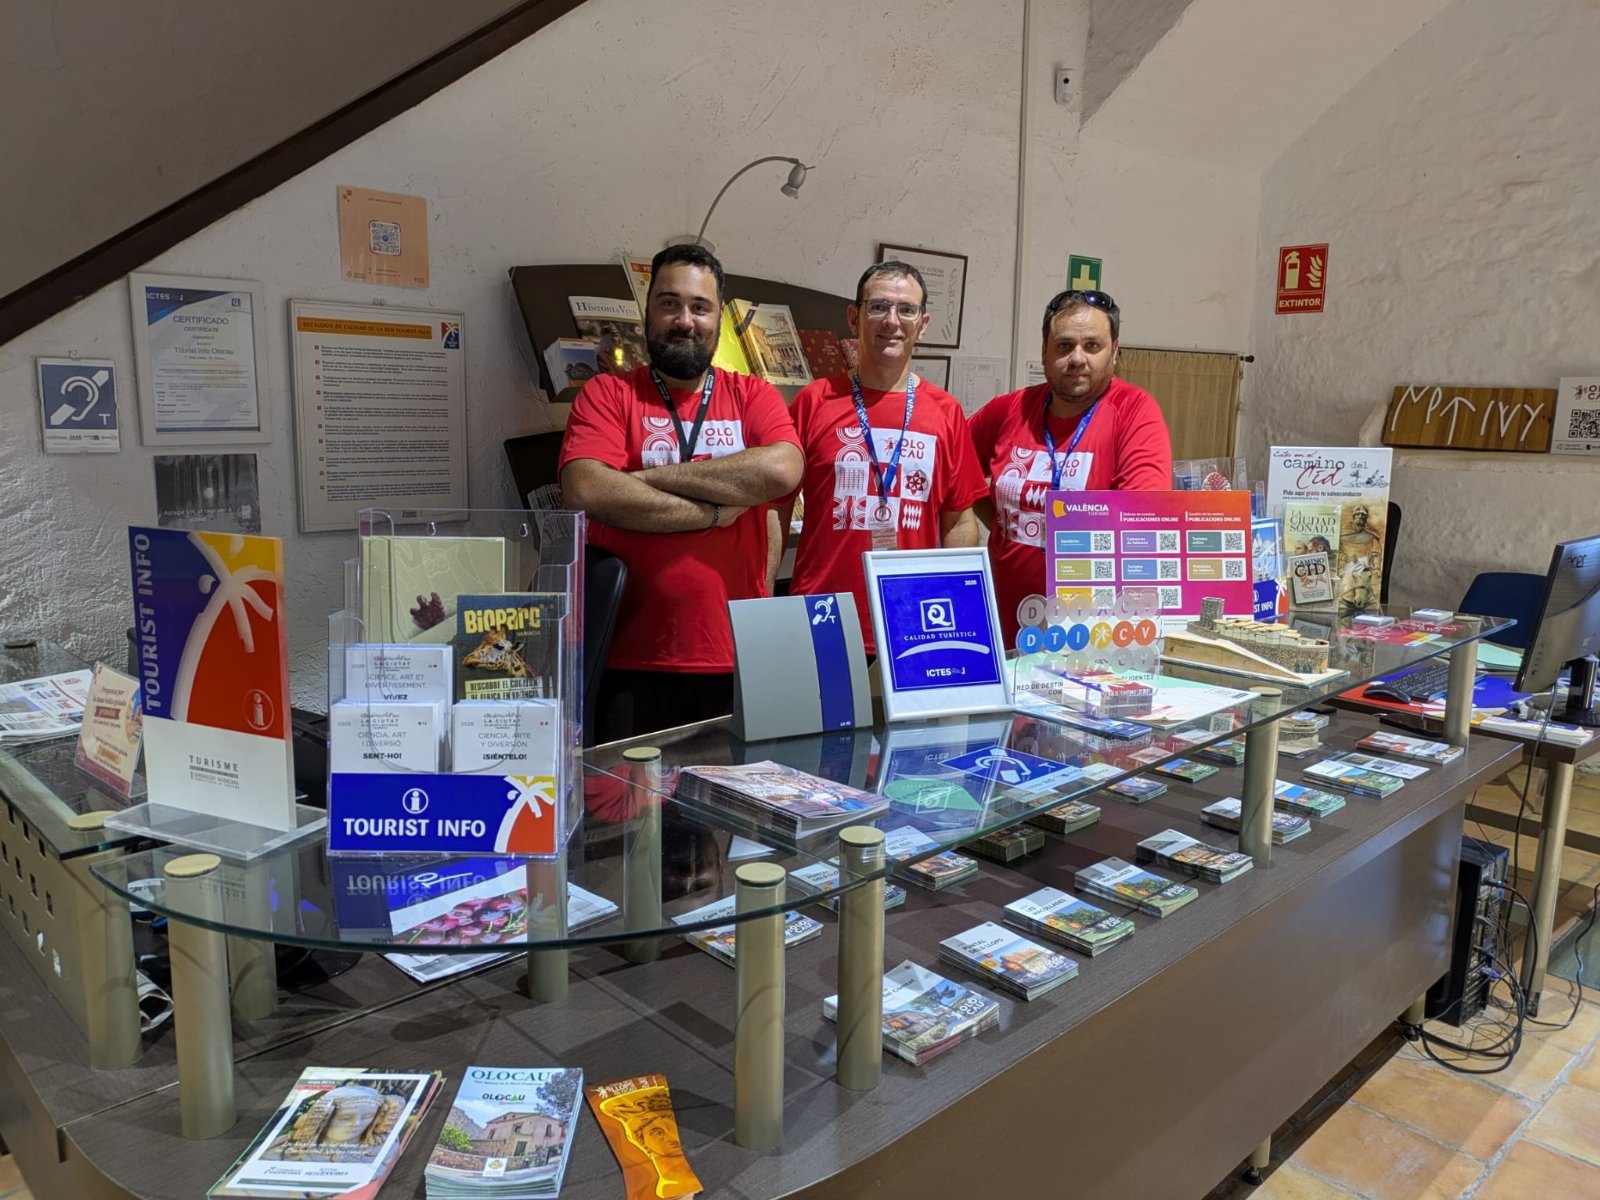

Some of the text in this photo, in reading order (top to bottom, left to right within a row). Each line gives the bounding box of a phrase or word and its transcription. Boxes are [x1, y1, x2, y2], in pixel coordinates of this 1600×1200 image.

[1280, 298, 1321, 308] EXTINTOR
[173, 315, 229, 325] CERTIFICADO
[98, 413, 111, 425] T
[705, 427, 733, 438] OLO
[705, 437, 734, 447] CAU
[900, 438, 925, 449] OLO
[900, 449, 925, 460] CAU
[1283, 456, 1368, 470] camino del
[1296, 463, 1343, 490] Cid
[1306, 490, 1320, 498] gratis
[1066, 502, 1109, 512] VALÈNCIA
[1290, 516, 1336, 526] CIUDAD
[1294, 558, 1325, 567] CAMINO
[1294, 563, 1326, 577] CID
[134, 533, 162, 711] TOURIST INFO
[904, 630, 977, 641] CALIDAD TURÍSTICA
[926, 667, 952, 678] ICTES
[392, 731, 408, 739] ART
[362, 752, 402, 760] SENT-HO!
[188, 754, 240, 772] TURISME
[343, 817, 486, 838] TOURIST INFO
[959, 997, 978, 1012] OLO
[966, 1001, 985, 1015] CAU
[471, 1070, 552, 1082] OLOCAU
